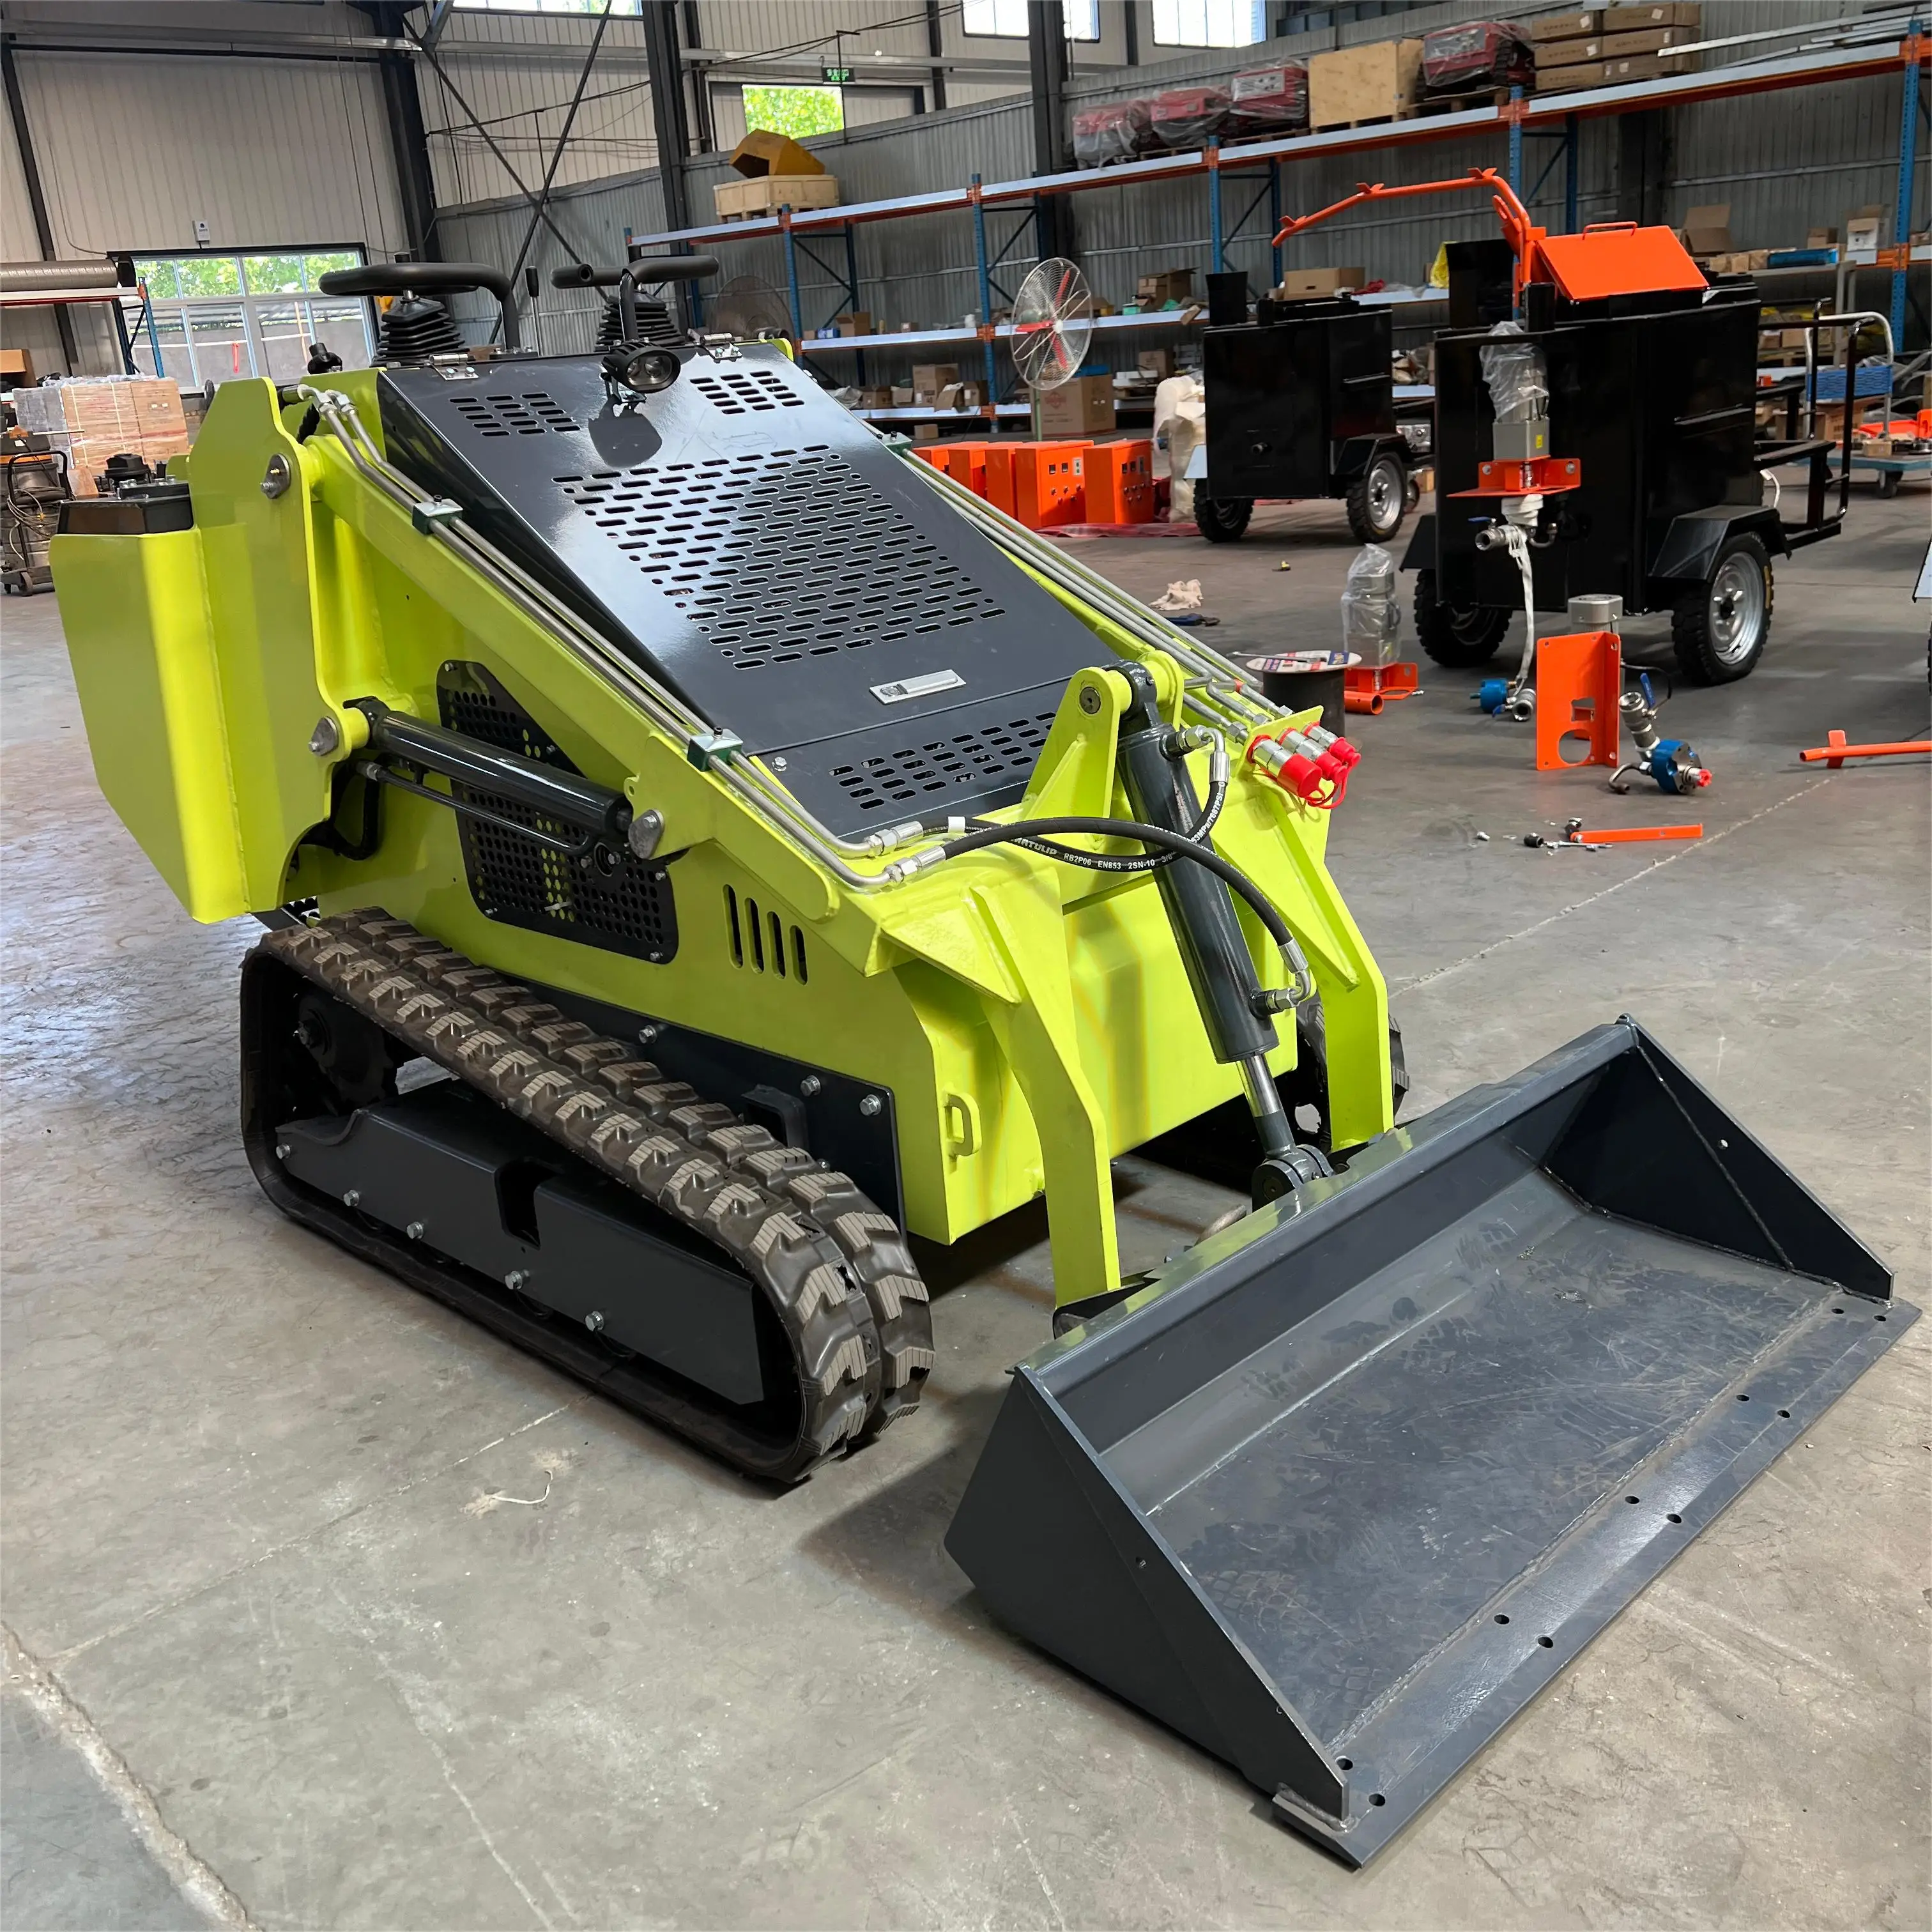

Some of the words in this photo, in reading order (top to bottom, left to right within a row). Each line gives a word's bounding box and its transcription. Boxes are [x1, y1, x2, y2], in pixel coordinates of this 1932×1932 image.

[1064, 853, 1092, 866] RB2P06
[1098, 860, 1121, 870] EN853
[1128, 859, 1155, 870] 2SN-10
